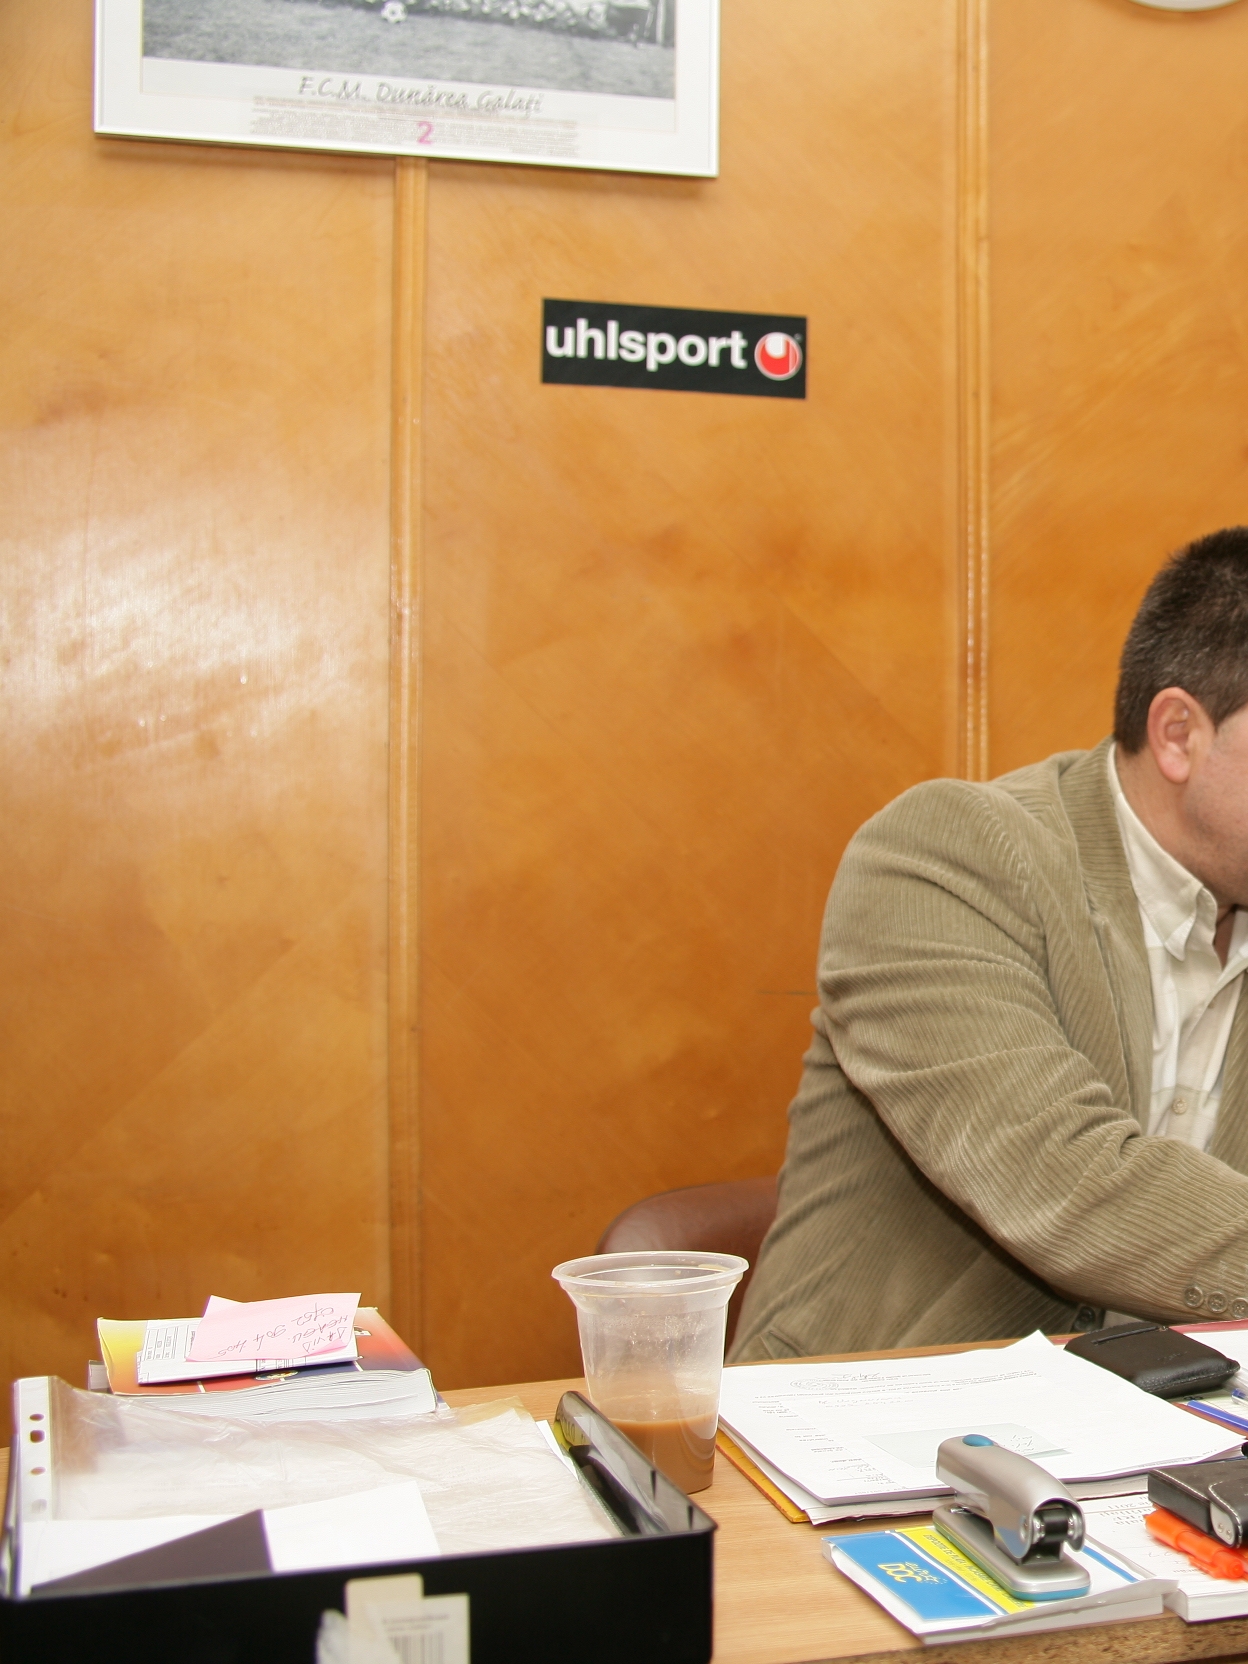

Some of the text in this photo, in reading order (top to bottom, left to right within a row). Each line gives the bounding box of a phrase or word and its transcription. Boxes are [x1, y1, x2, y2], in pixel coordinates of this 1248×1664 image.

[299, 76, 367, 100] F.C.M.
[417, 121, 434, 144] 2
[546, 317, 748, 372] uhlsport
[877, 1563, 922, 1583] DOC
